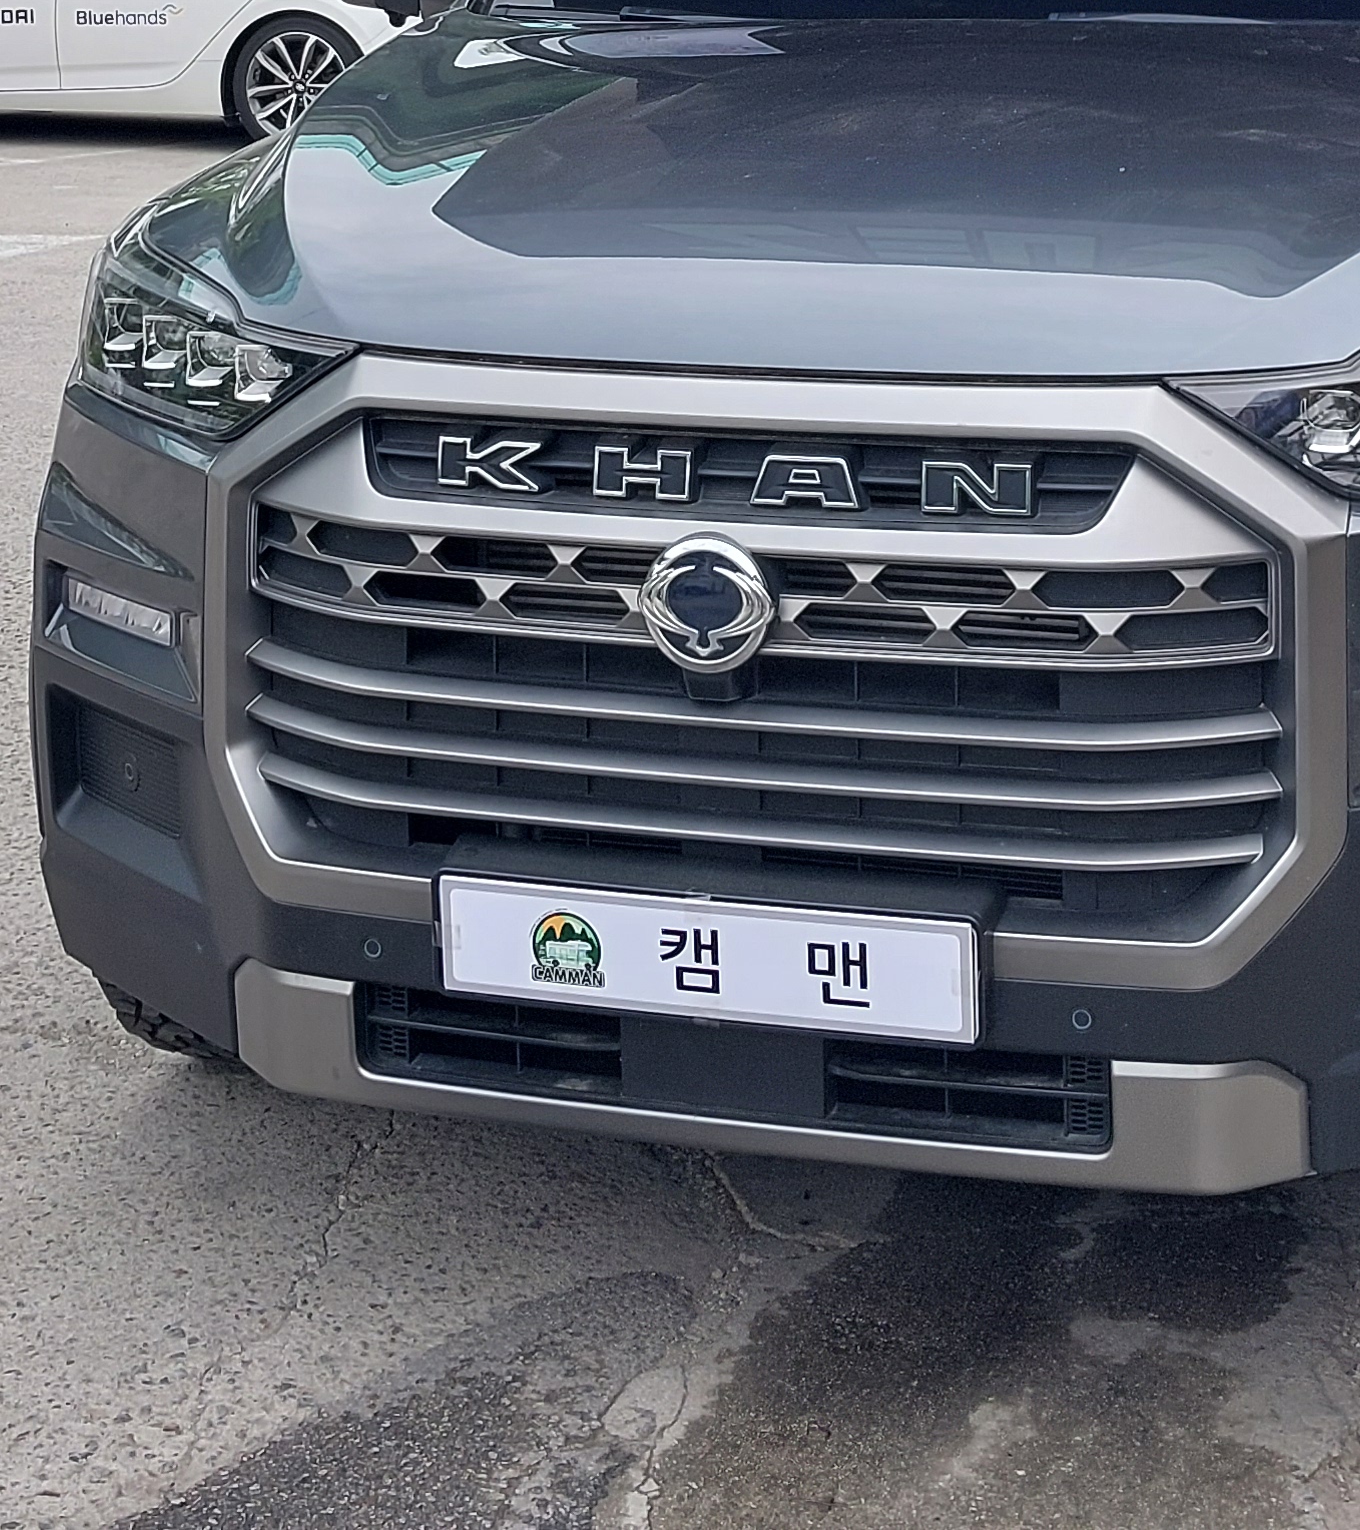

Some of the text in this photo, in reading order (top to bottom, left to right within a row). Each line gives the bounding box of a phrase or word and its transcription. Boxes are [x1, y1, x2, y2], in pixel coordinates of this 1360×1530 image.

[76, 9, 167, 25] Bluehands
[437, 434, 1034, 516] KHAN
[531, 964, 605, 988] CAMMAN
